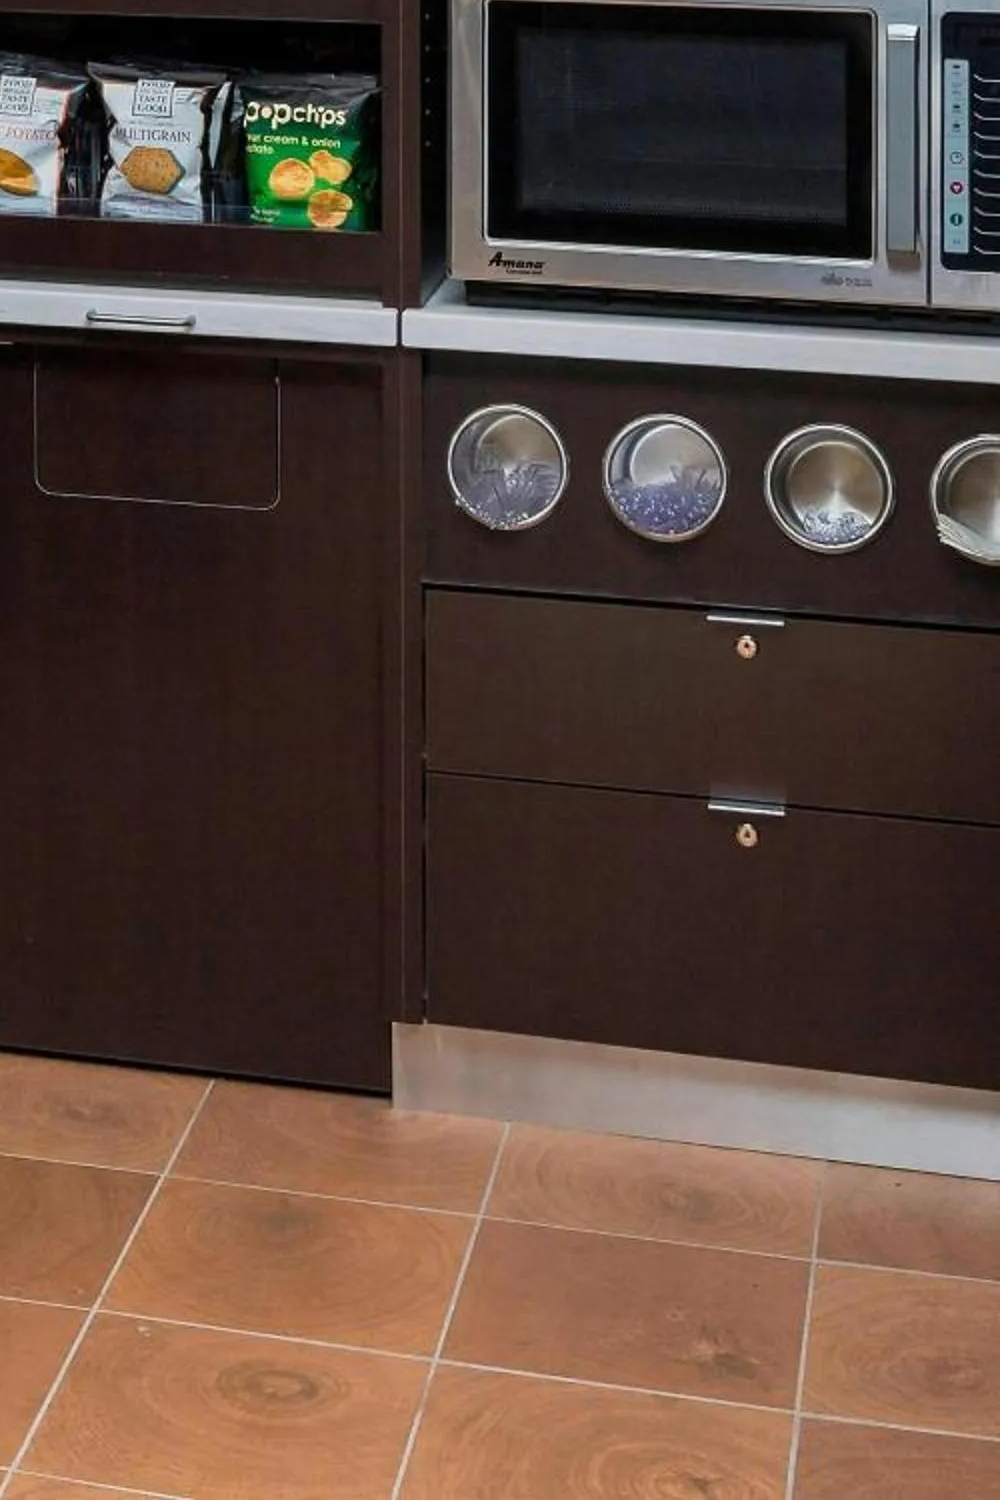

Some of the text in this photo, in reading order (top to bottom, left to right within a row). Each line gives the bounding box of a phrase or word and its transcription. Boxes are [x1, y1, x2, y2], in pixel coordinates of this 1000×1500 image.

[243, 101, 347, 130] popchips
[263, 134, 299, 145] cream
[301, 136, 309, 146] &
[311, 138, 341, 148] onion
[488, 251, 546, 269] Amana
